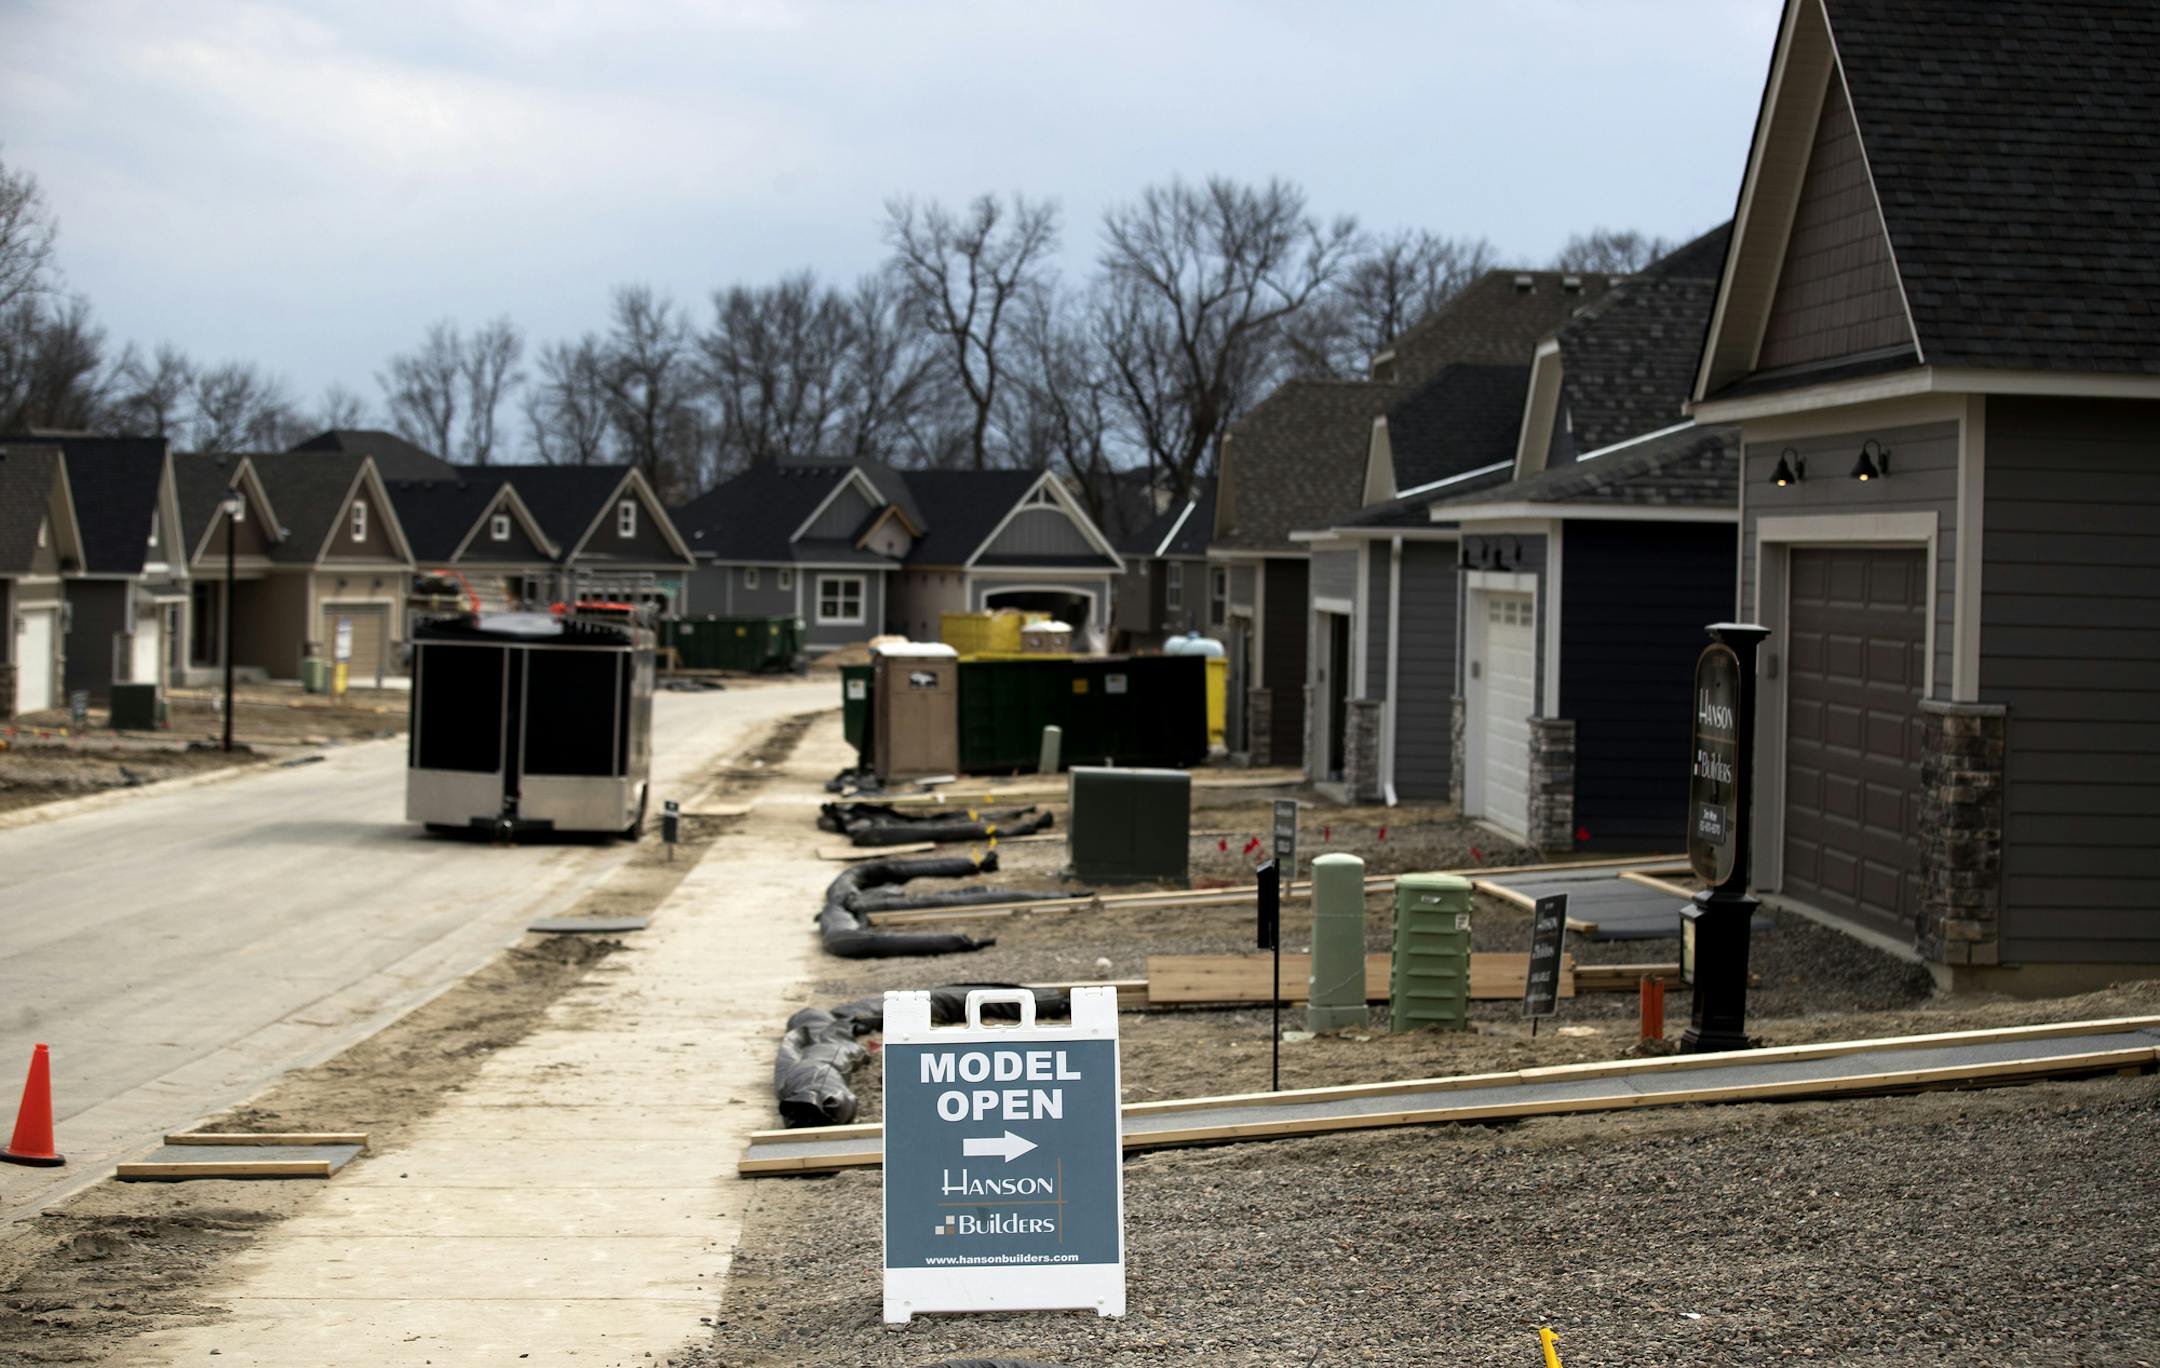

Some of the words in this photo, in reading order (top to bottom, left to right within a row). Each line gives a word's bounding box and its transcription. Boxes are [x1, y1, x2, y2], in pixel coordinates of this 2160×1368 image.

[920, 1050, 1082, 1084] MODEL
[936, 1088, 1063, 1122] OPEN
[941, 1168, 1053, 1196] HANSON
[925, 1253, 1078, 1265] www.hansonbuilders.com
